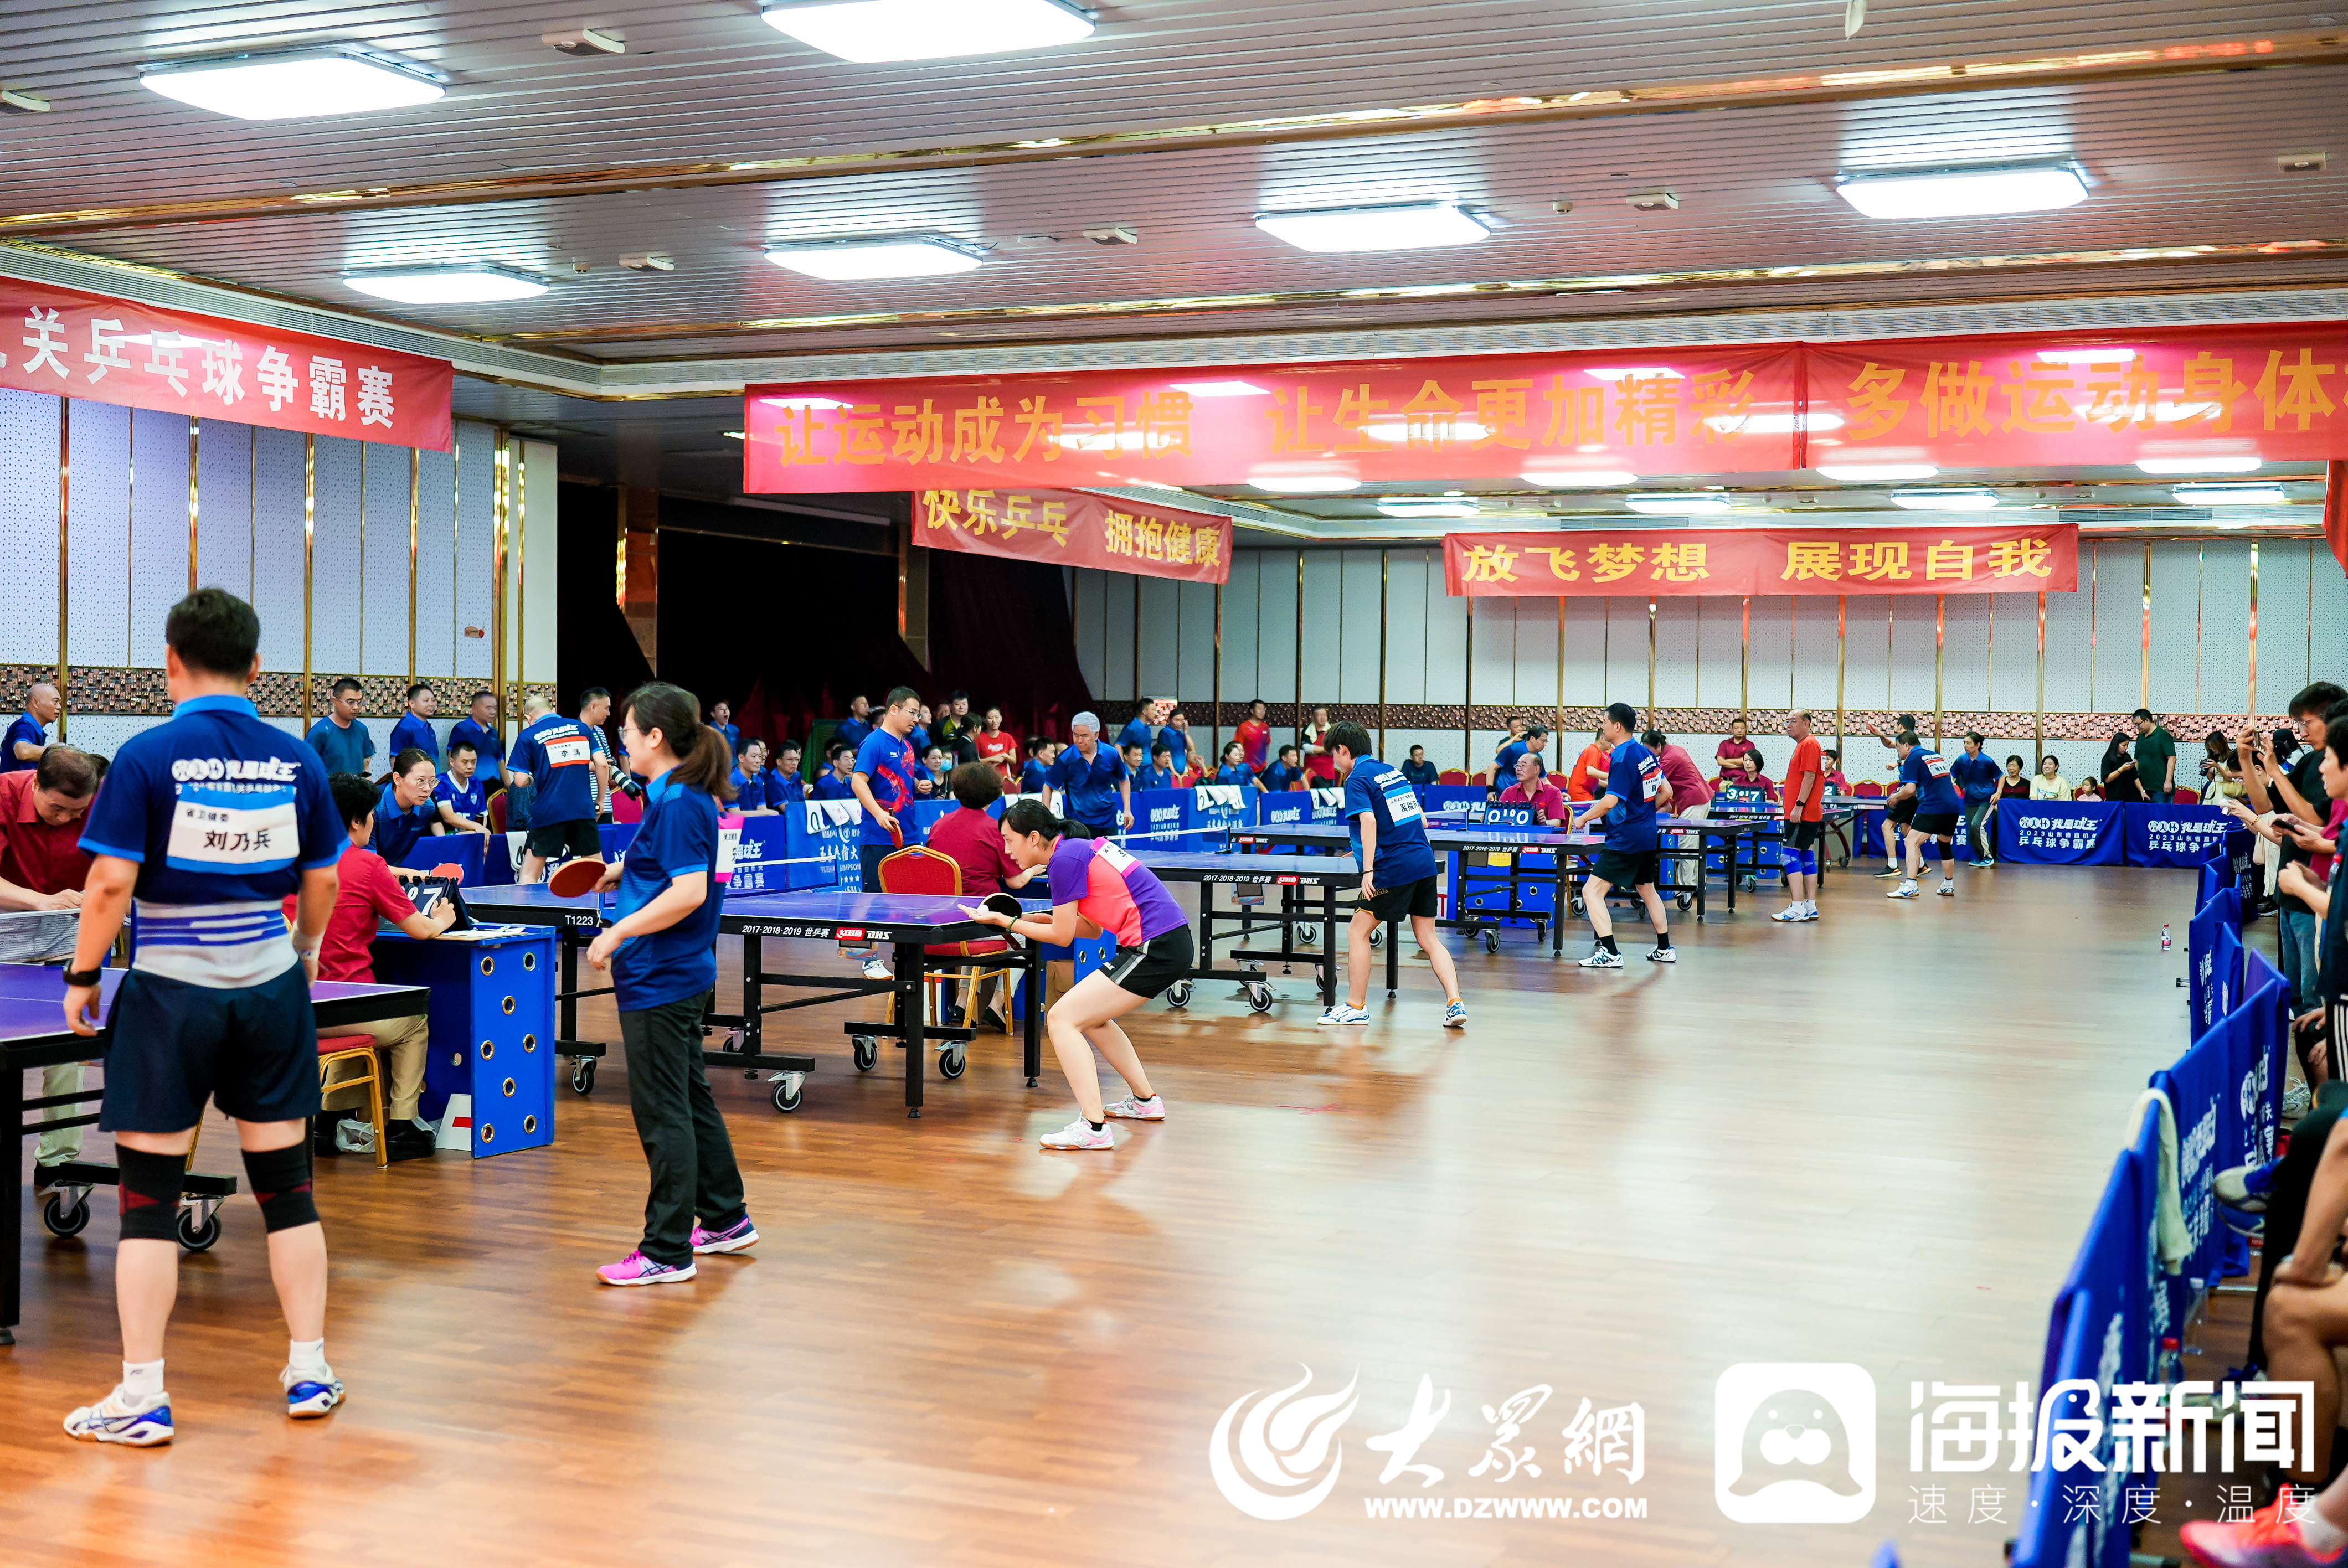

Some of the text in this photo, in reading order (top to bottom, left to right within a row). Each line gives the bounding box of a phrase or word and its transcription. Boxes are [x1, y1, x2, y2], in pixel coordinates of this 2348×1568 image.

[0, 305, 395, 429] 关乒乓球争霸赛
[1847, 348, 2348, 441] 多做运动身体
[775, 369, 1756, 466] 让运动成为习惯 让生命更加精彩
[923, 489, 1221, 568] 快乐乒乓 拥抱健康
[1462, 539, 2053, 584] 放飞梦想 展现自我
[1727, 789, 1737, 800] 3
[1751, 791, 1760, 801] 7
[1488, 809, 1501, 823] 0
[1516, 811, 1529, 824] 0
[204, 828, 271, 851] 刘乃兵
[840, 863, 861, 871] SIMPSON
[421, 887, 443, 916] 7
[565, 915, 594, 926] T1223
[742, 925, 802, 935] 2017·2018·2019
[805, 927, 830, 938] 世乒赛
[866, 930, 892, 940] DHS
